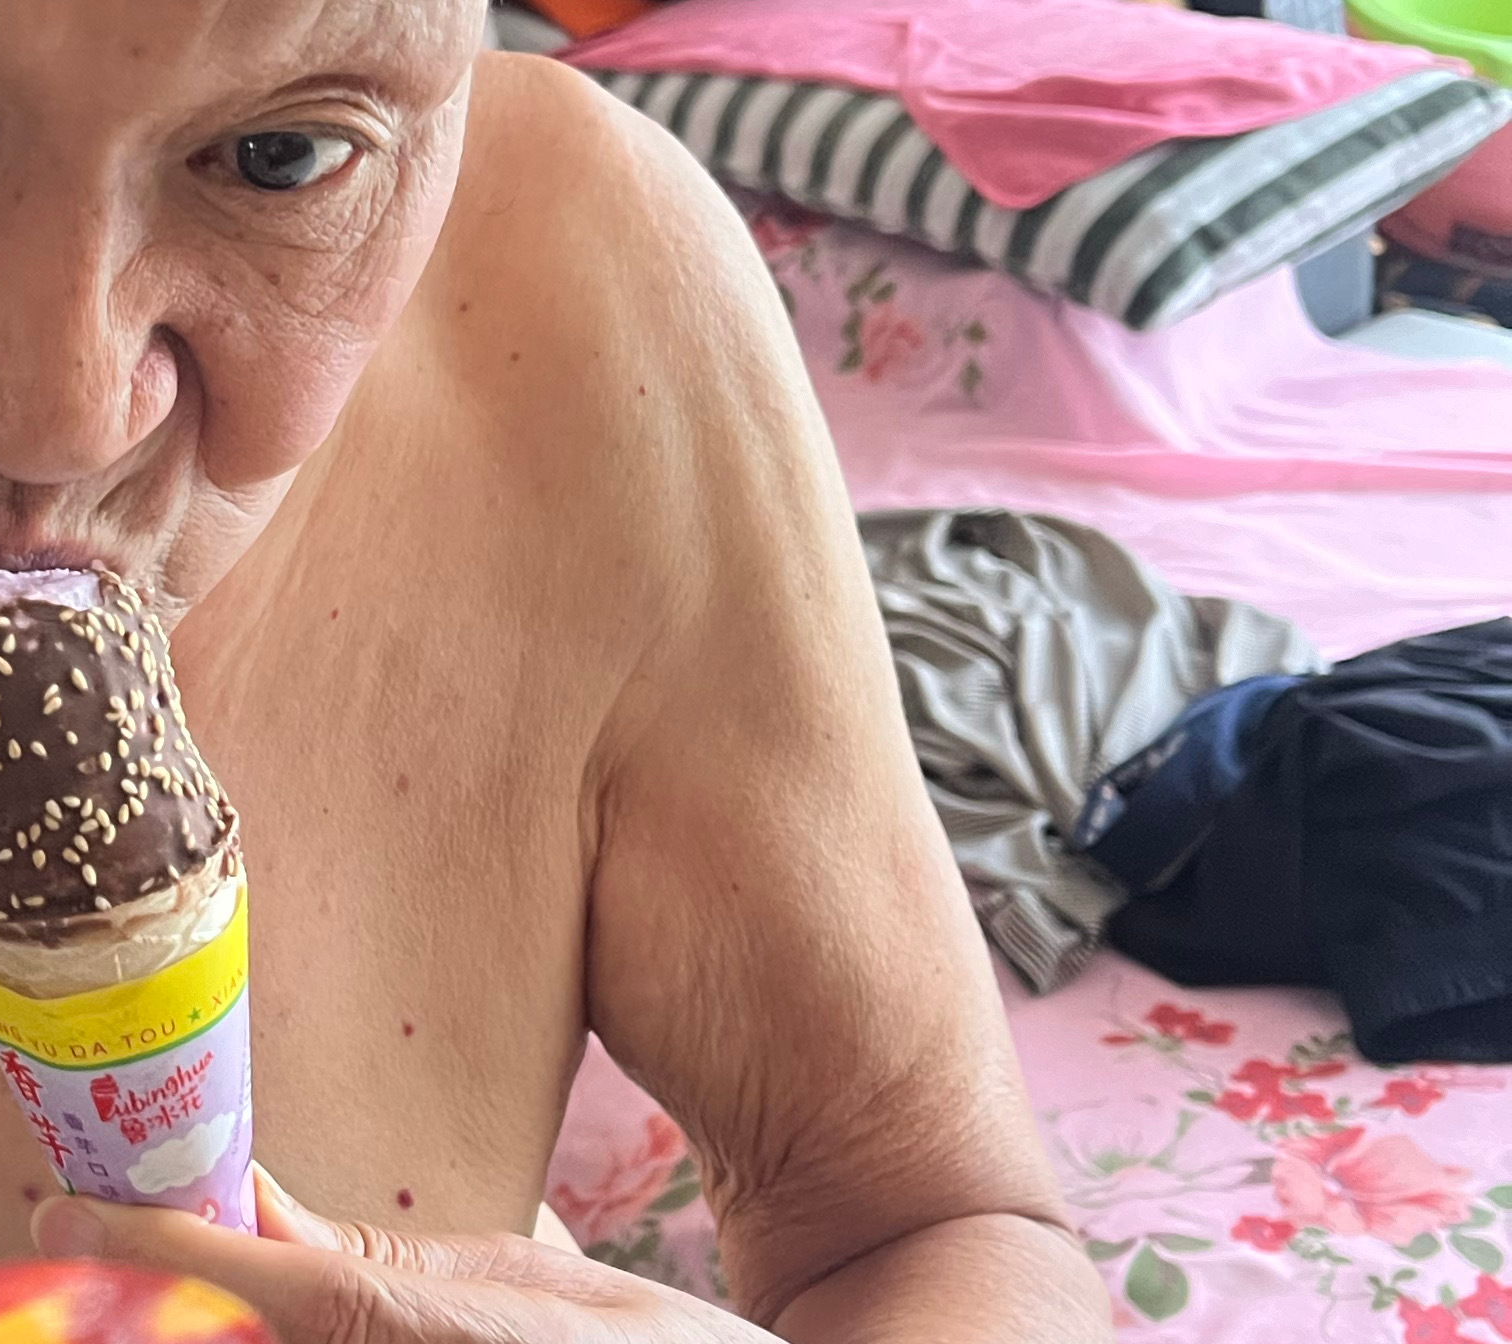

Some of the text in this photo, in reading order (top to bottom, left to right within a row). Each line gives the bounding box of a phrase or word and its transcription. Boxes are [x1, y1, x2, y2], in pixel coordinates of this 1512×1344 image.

[68, 1041, 108, 1060] DA
[120, 1019, 177, 1050] TOU
[0, 1049, 75, 1170] 香芋
